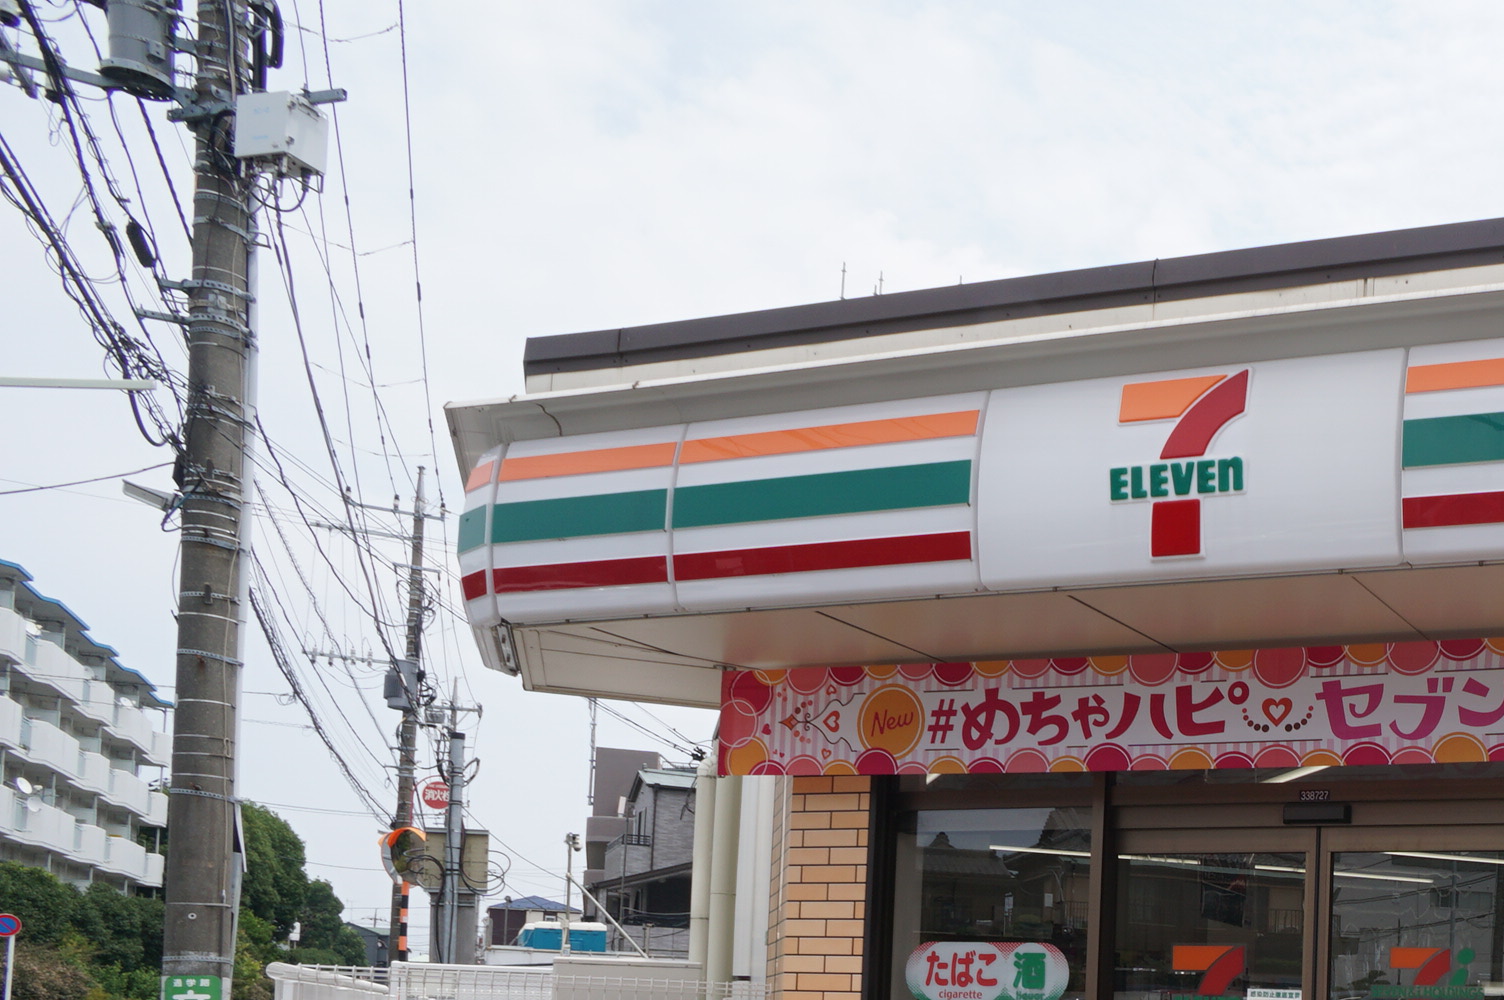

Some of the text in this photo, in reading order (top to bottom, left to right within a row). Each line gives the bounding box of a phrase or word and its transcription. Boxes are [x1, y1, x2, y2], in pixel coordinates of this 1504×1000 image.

[871, 709, 914, 737] New
[1300, 790, 1329, 801] 338727
[925, 951, 1047, 989] たばこ 酒
[938, 989, 983, 1000] cigarette
